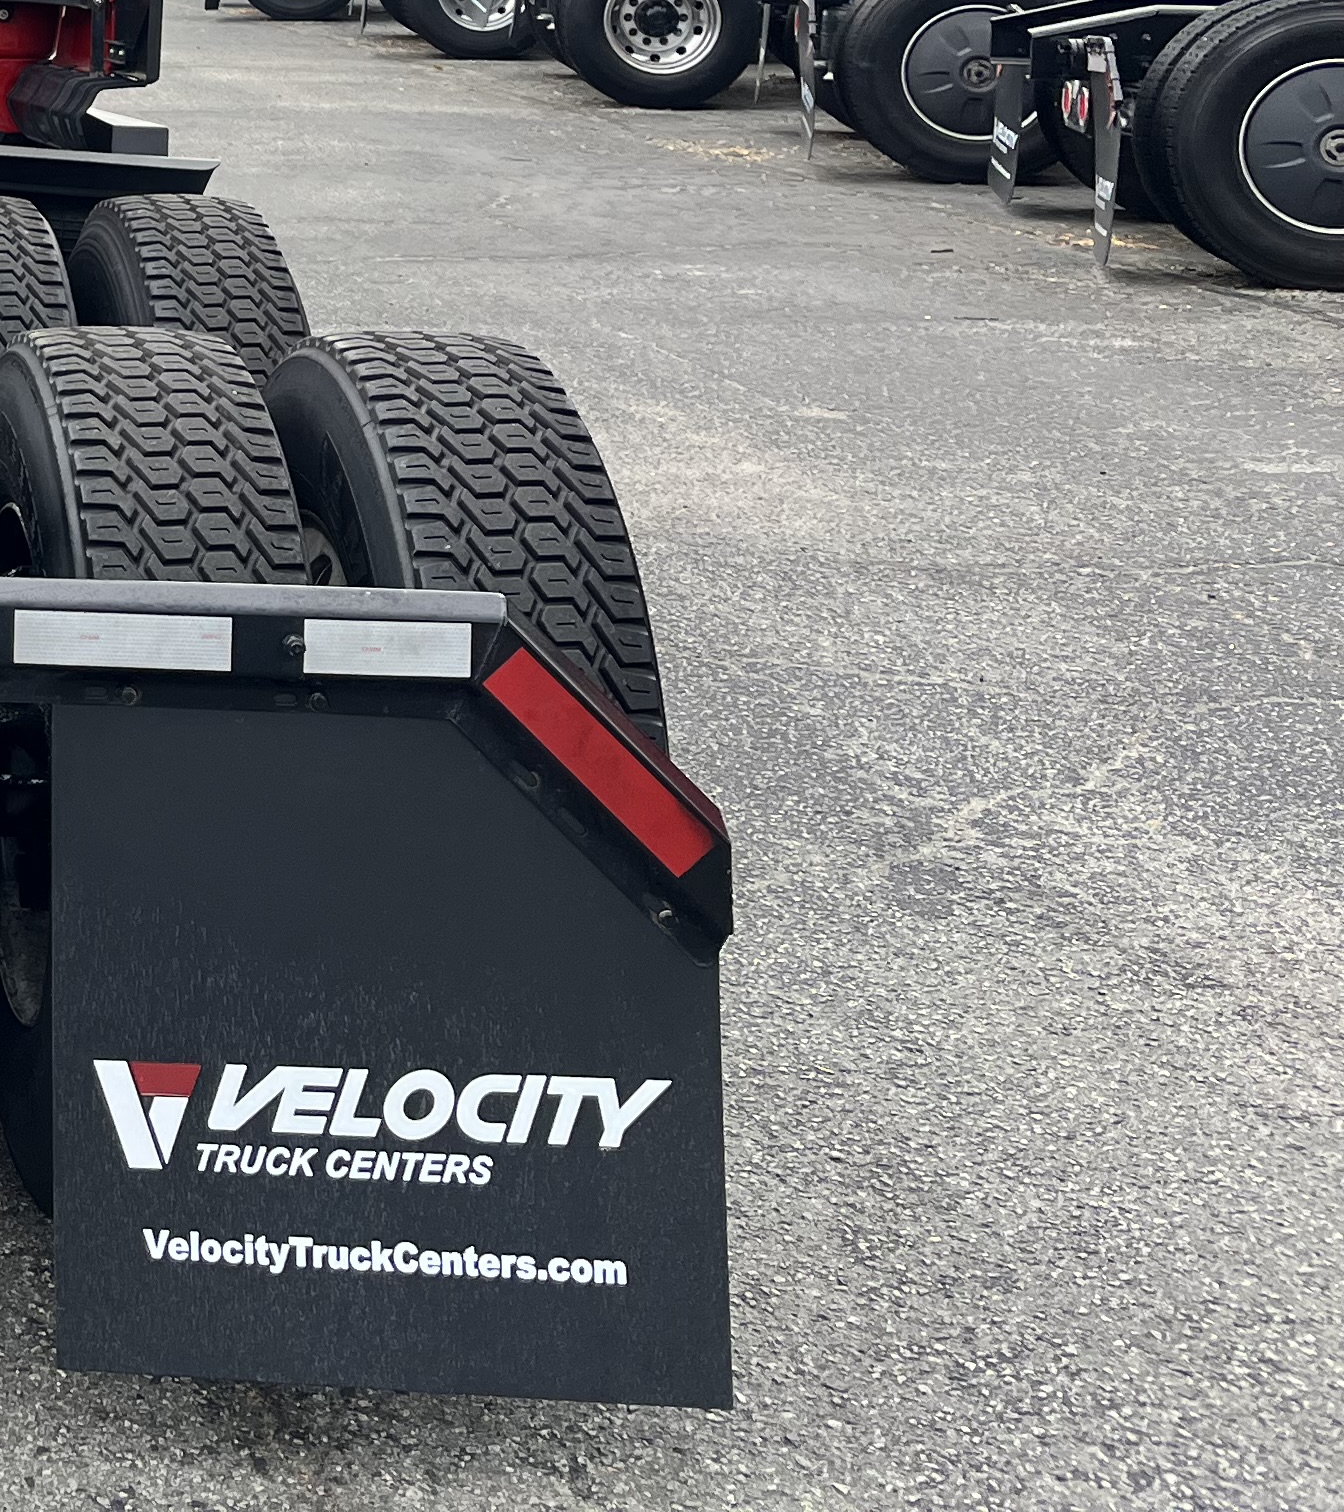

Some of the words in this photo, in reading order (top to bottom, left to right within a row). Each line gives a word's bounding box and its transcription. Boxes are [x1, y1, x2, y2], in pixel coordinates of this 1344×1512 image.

[208, 1064, 672, 1148] VELOCITY
[197, 1143, 318, 1176] TRUCK
[326, 1149, 493, 1185] CENTERS
[143, 1229, 627, 1285] VelocityTruckCenters.com
